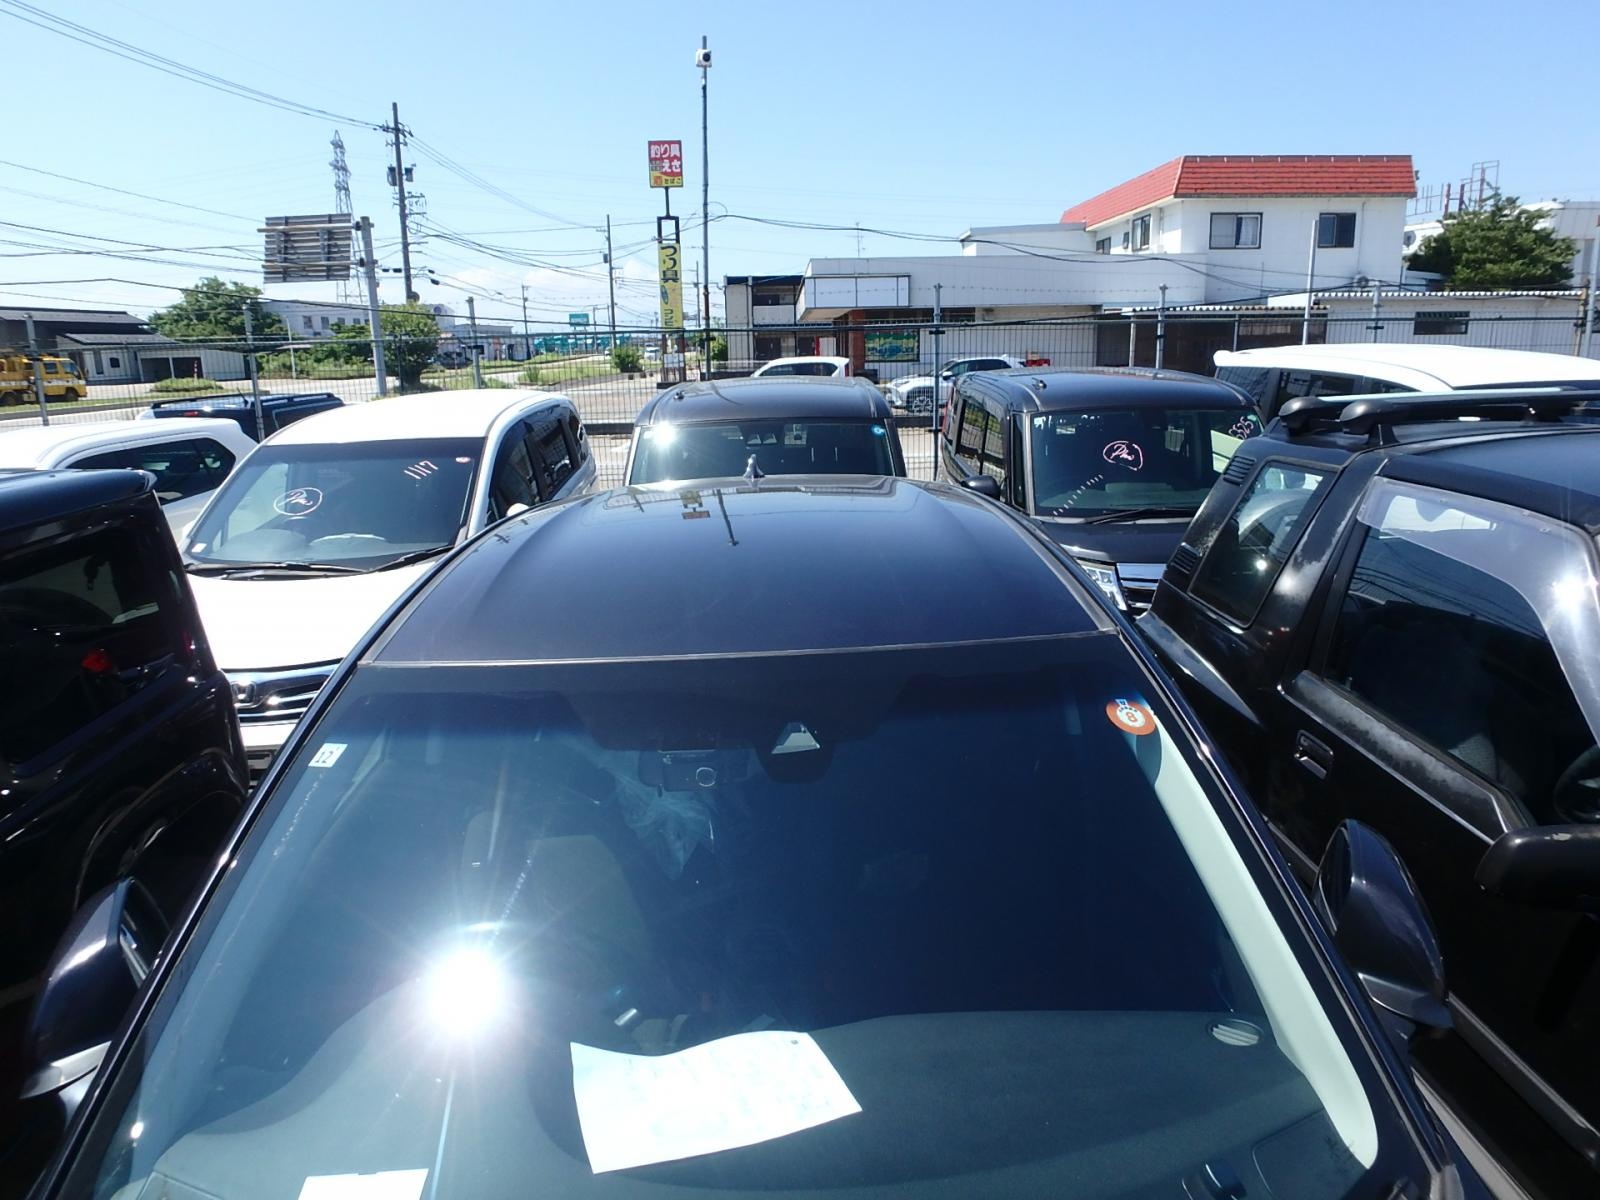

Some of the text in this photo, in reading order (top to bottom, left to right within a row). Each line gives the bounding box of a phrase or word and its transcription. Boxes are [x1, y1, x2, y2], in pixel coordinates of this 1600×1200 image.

[660, 245, 679, 284] つり具
[403, 460, 439, 480] 1117
